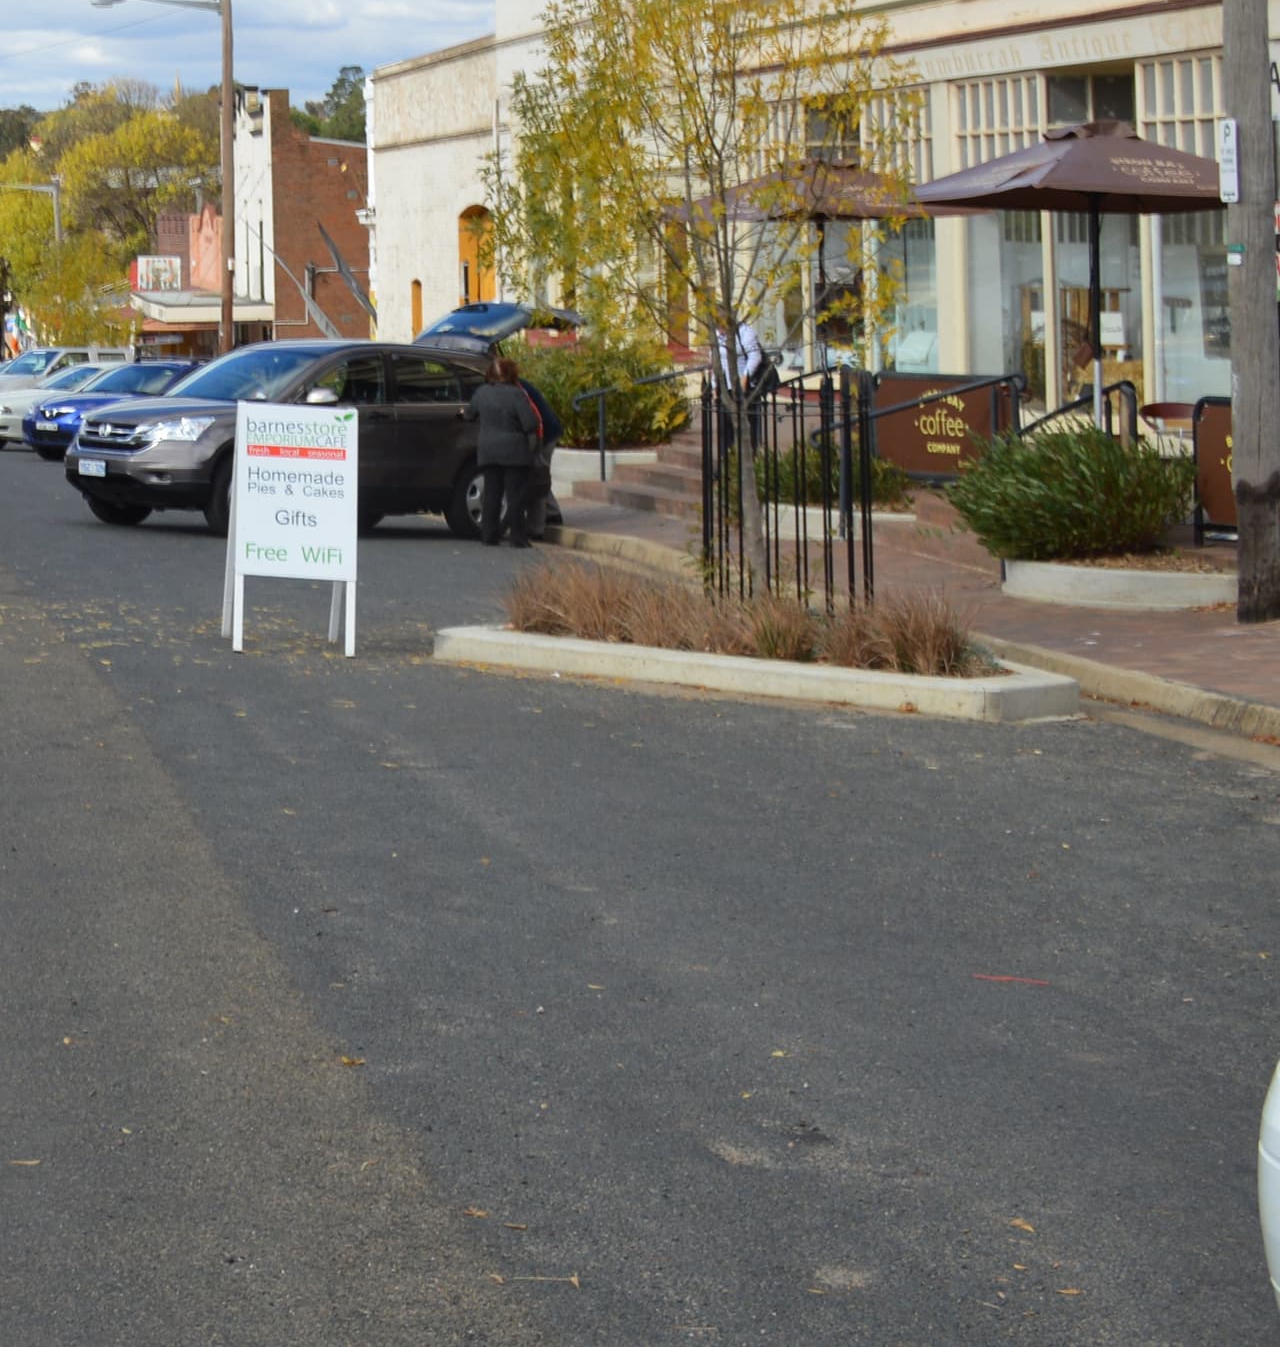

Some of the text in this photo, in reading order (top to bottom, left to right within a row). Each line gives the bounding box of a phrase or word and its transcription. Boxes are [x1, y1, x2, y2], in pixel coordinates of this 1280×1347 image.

[920, 408, 965, 438] coffee
[248, 446, 270, 455] fresh
[307, 449, 344, 459] seasonal
[927, 441, 961, 455] COMPANY
[248, 466, 345, 486] Homemade
[247, 482, 345, 499] Pies & Cakes
[275, 509, 318, 527] Gifts
[245, 542, 344, 566] Free WiFi
